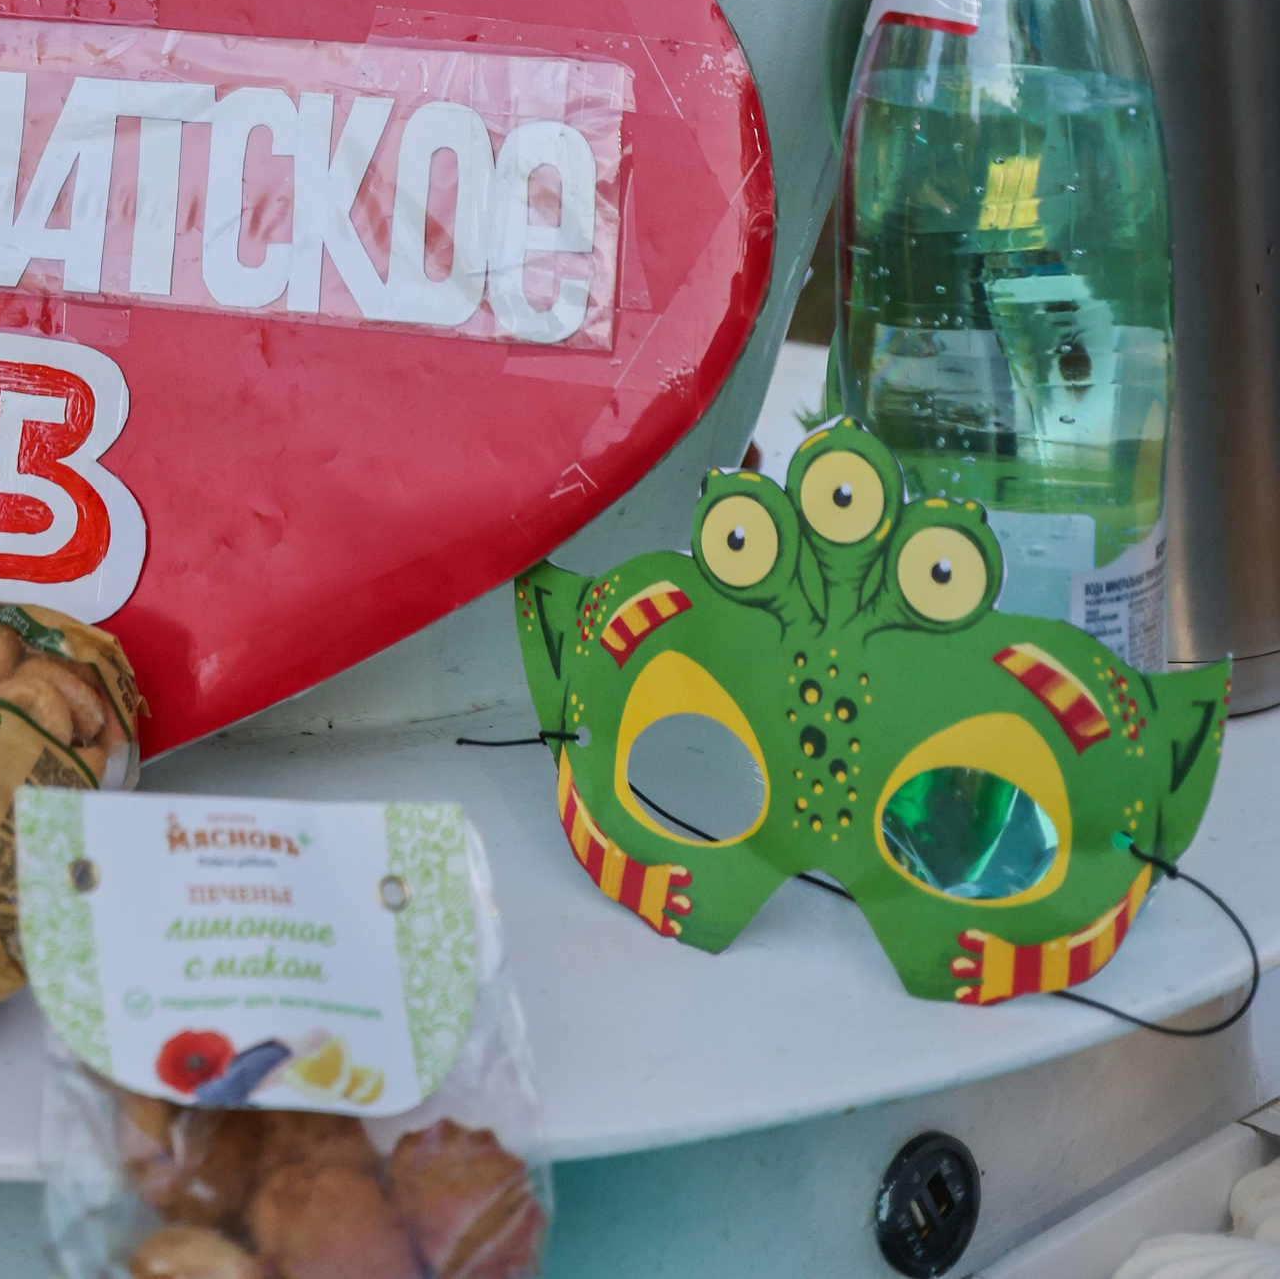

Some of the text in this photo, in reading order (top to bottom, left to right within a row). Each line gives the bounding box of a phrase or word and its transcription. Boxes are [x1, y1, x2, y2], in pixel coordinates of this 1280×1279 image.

[165, 916, 335, 947] лимонное
[183, 945, 328, 983] с маком
